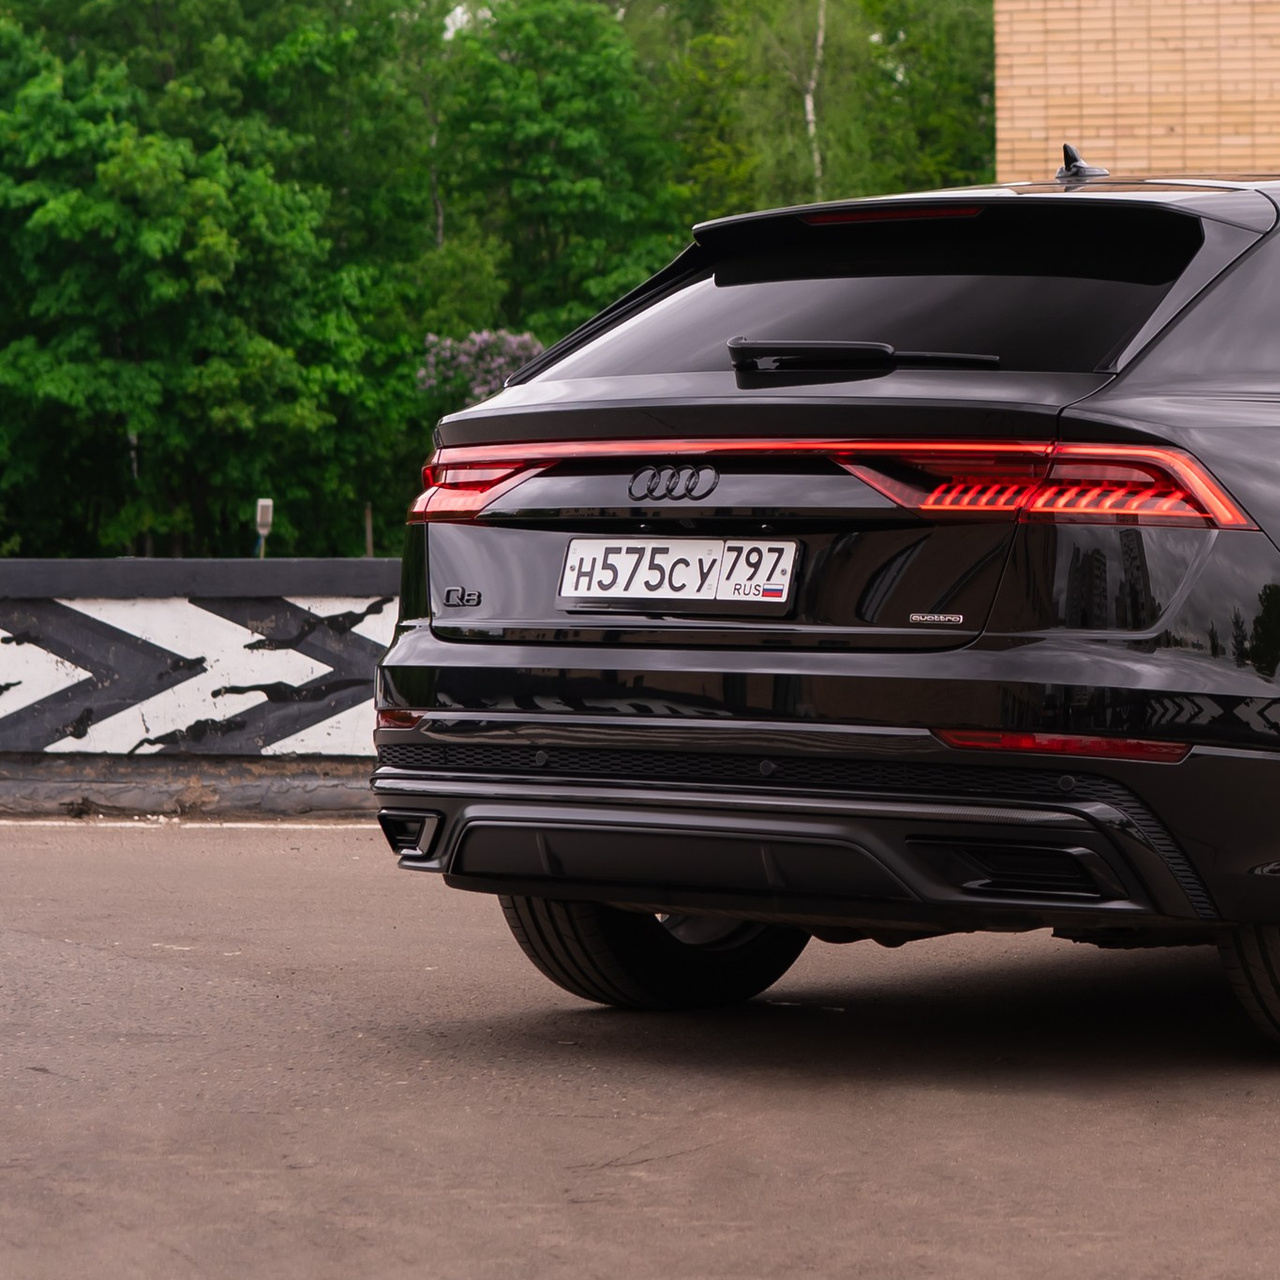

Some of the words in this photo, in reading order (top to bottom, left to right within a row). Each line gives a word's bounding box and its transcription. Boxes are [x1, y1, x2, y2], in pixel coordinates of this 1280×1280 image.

[725, 546, 785, 582] 797
[443, 586, 482, 607] Q8
[733, 583, 761, 596] RUS
